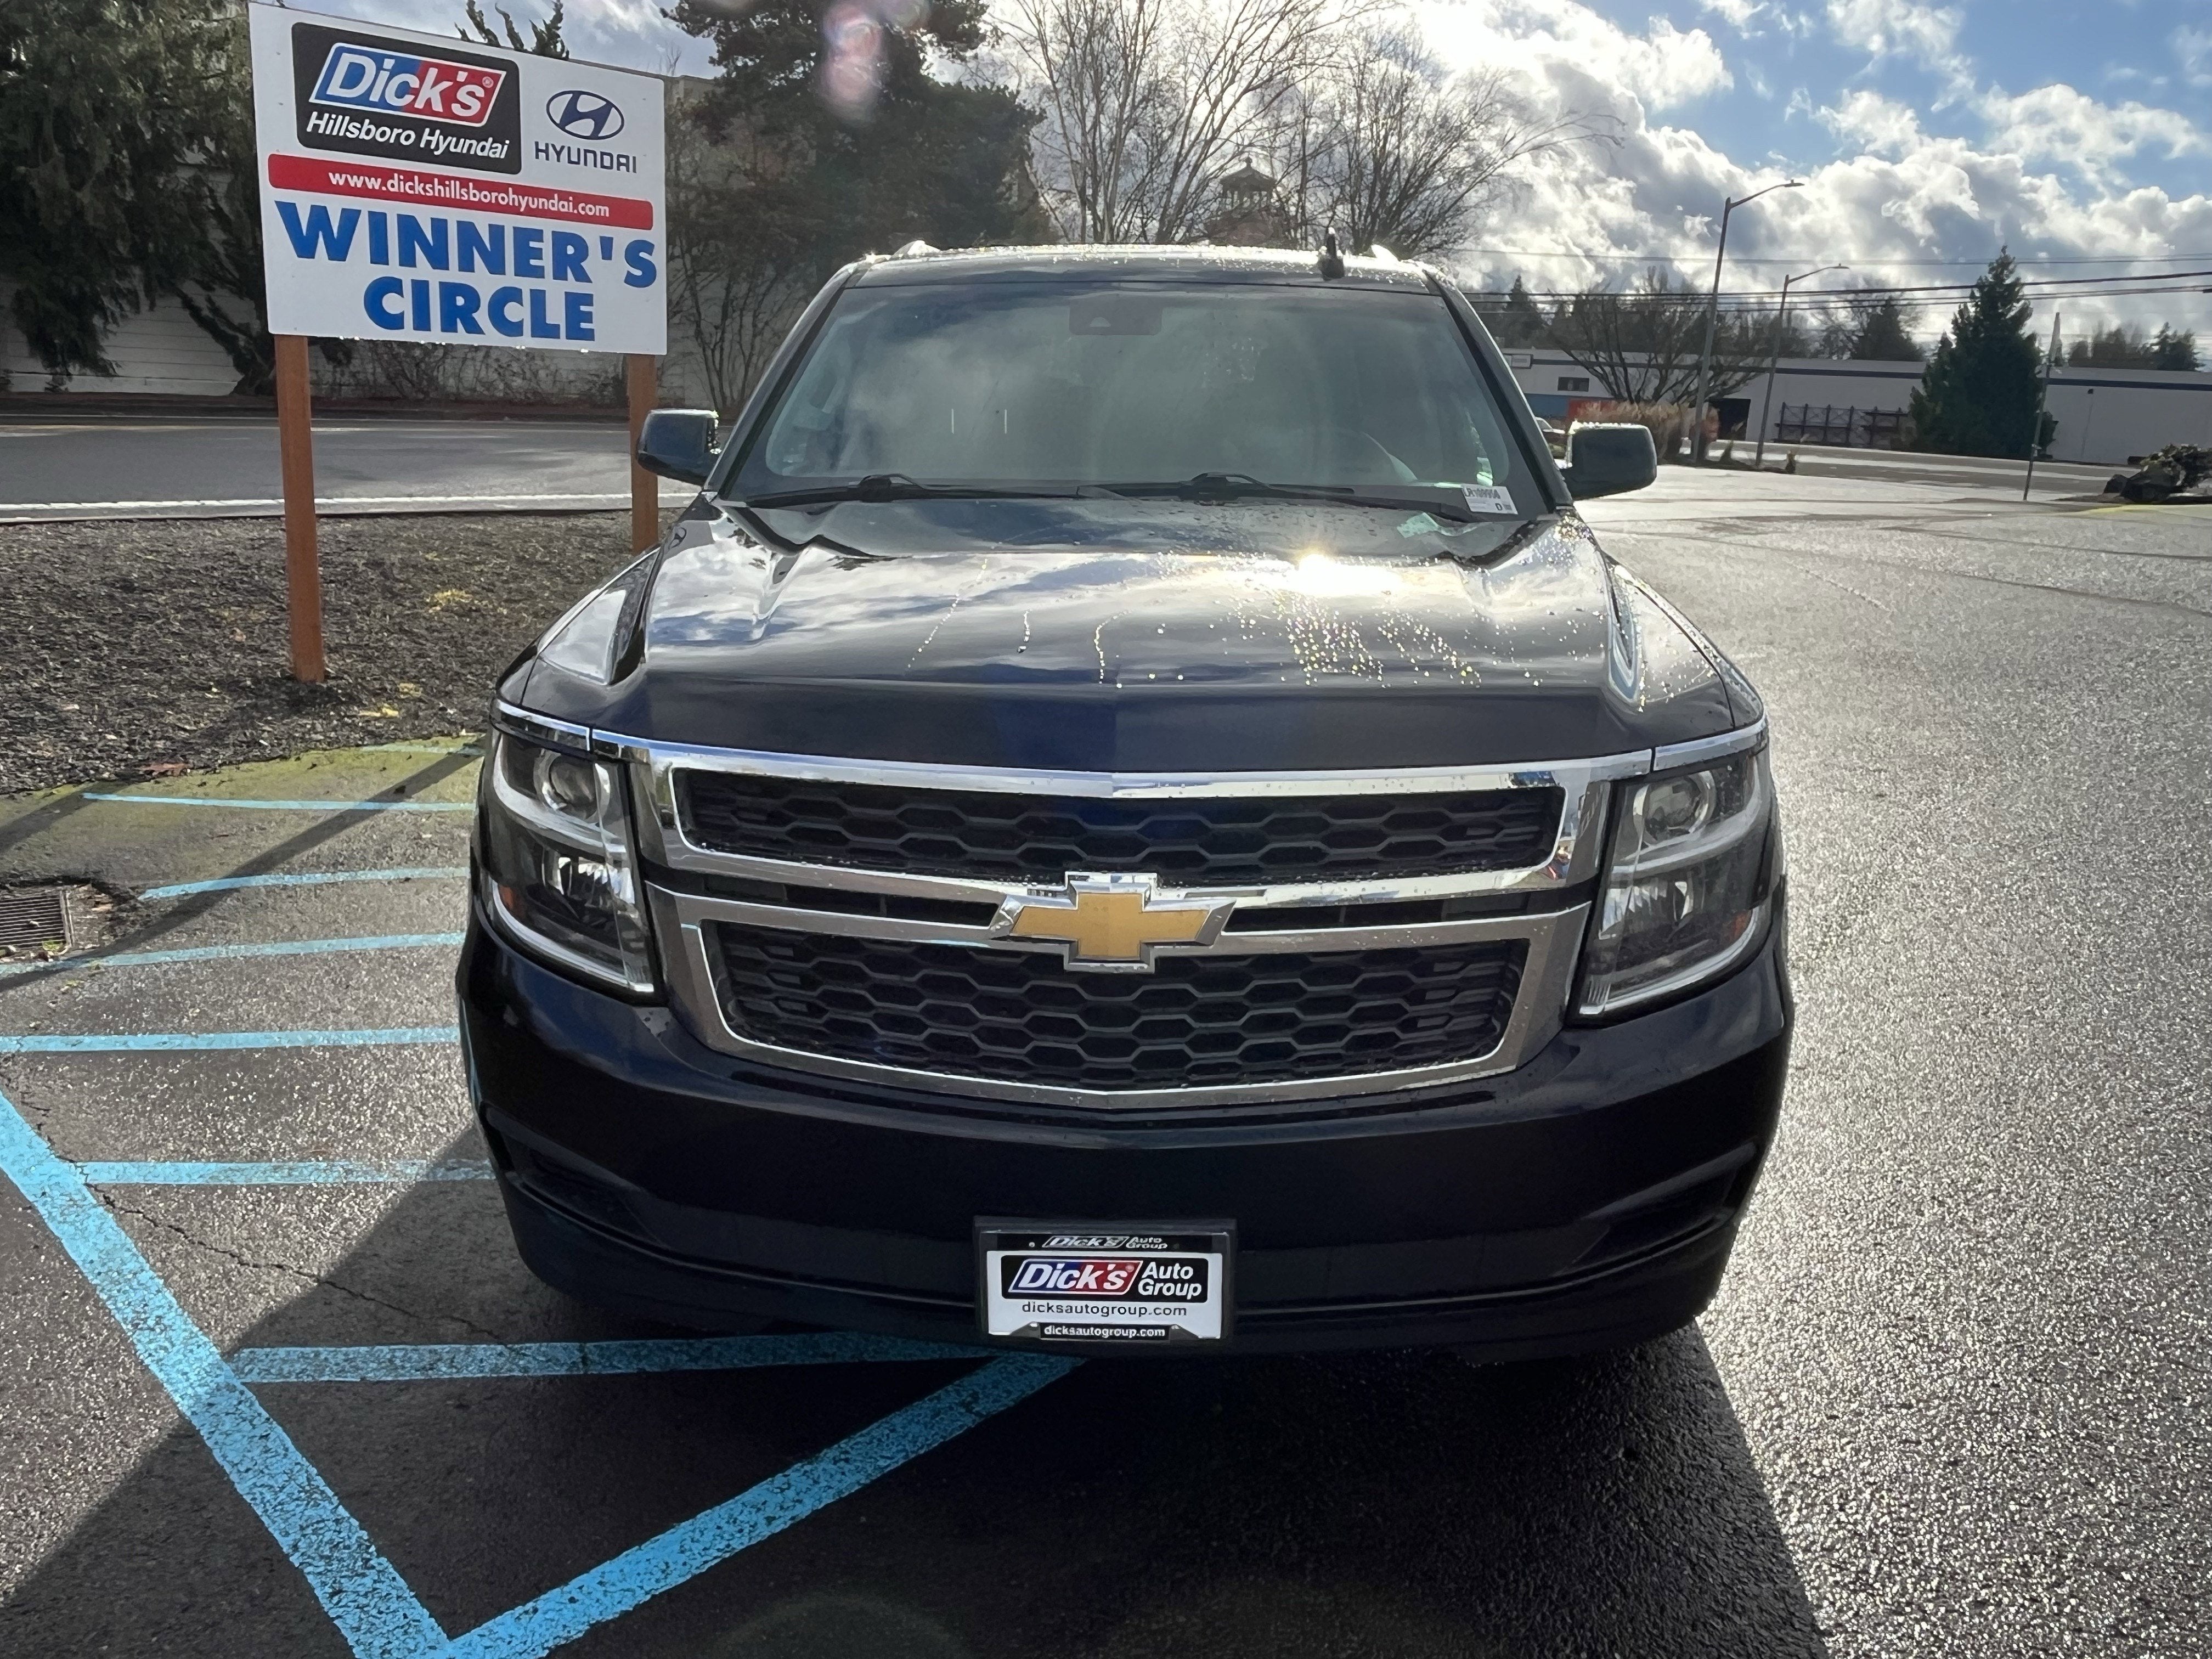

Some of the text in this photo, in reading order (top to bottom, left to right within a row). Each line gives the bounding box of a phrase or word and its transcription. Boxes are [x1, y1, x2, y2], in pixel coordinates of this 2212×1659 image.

[326, 52, 485, 117] Dick's
[306, 111, 510, 159] Hillsboro Hyundai
[534, 141, 636, 173] HYUNDAI
[329, 171, 610, 218] www.dickshillsborohyundai.com
[274, 200, 657, 288] WINNER'S
[363, 276, 595, 341] CIRCLE
[1018, 1263, 1127, 1289] Dick's
[1141, 1262, 1193, 1279] Auto
[1138, 1278, 1202, 1300] Group
[1022, 1301, 1187, 1317] dicksautogroup.com
[1045, 1325, 1165, 1338] dicksautogroup.com
